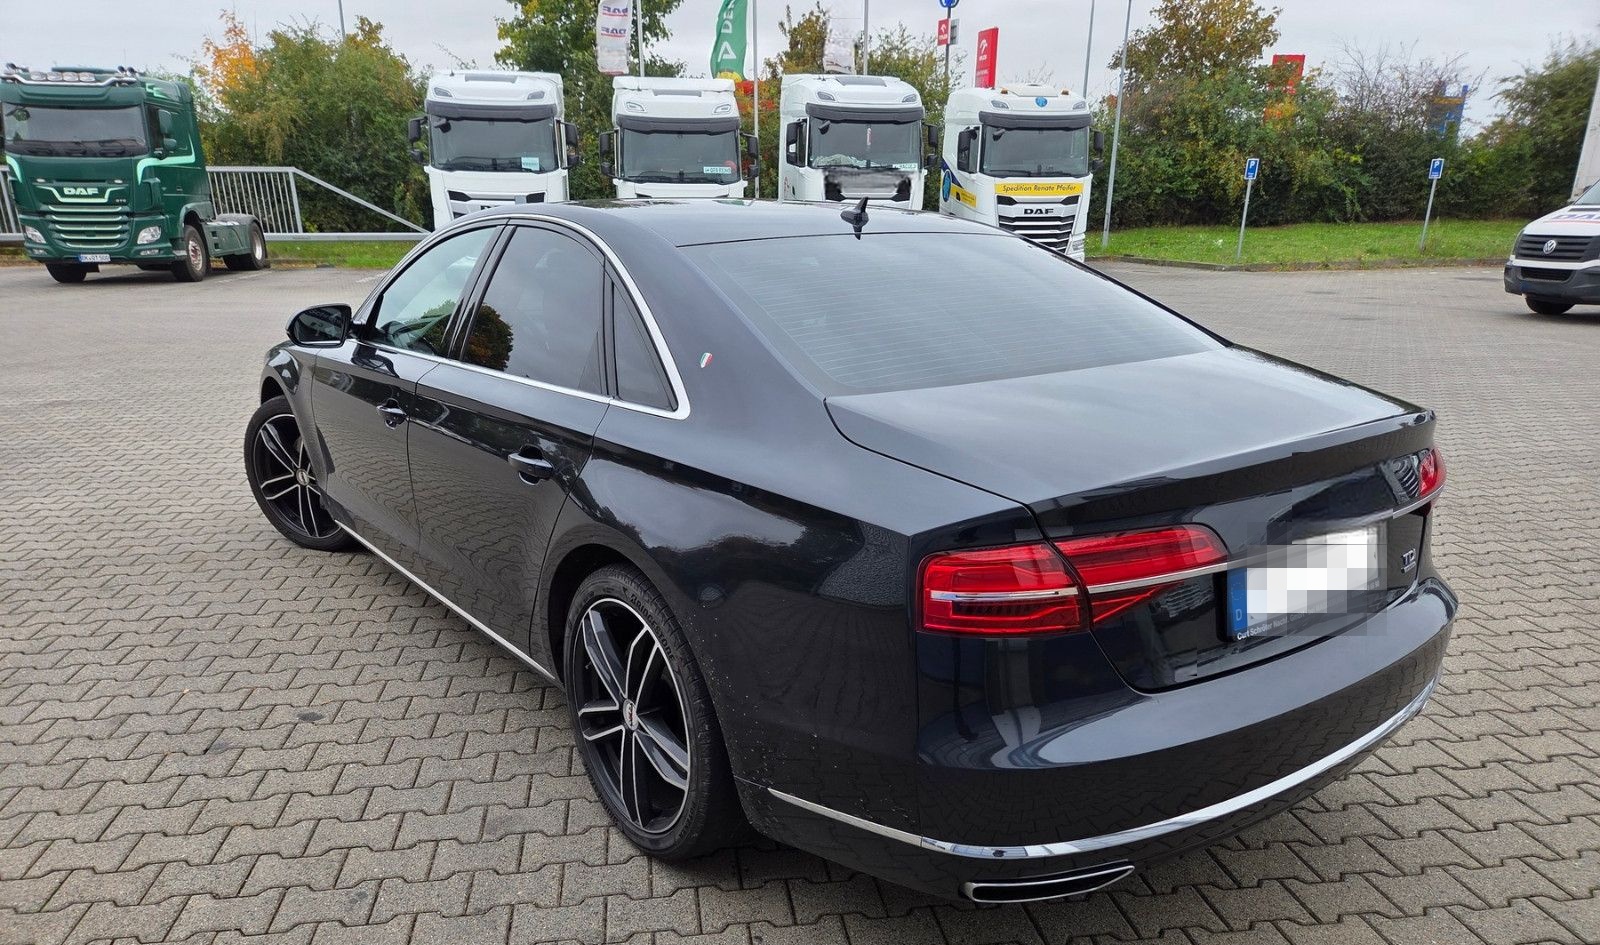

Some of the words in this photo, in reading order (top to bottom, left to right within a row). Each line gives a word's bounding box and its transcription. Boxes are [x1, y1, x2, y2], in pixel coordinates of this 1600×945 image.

[63, 187, 99, 195] DAF
[1002, 184, 1032, 193] Spedition
[1236, 609, 1242, 620] D
[1237, 630, 1250, 640] Curt
